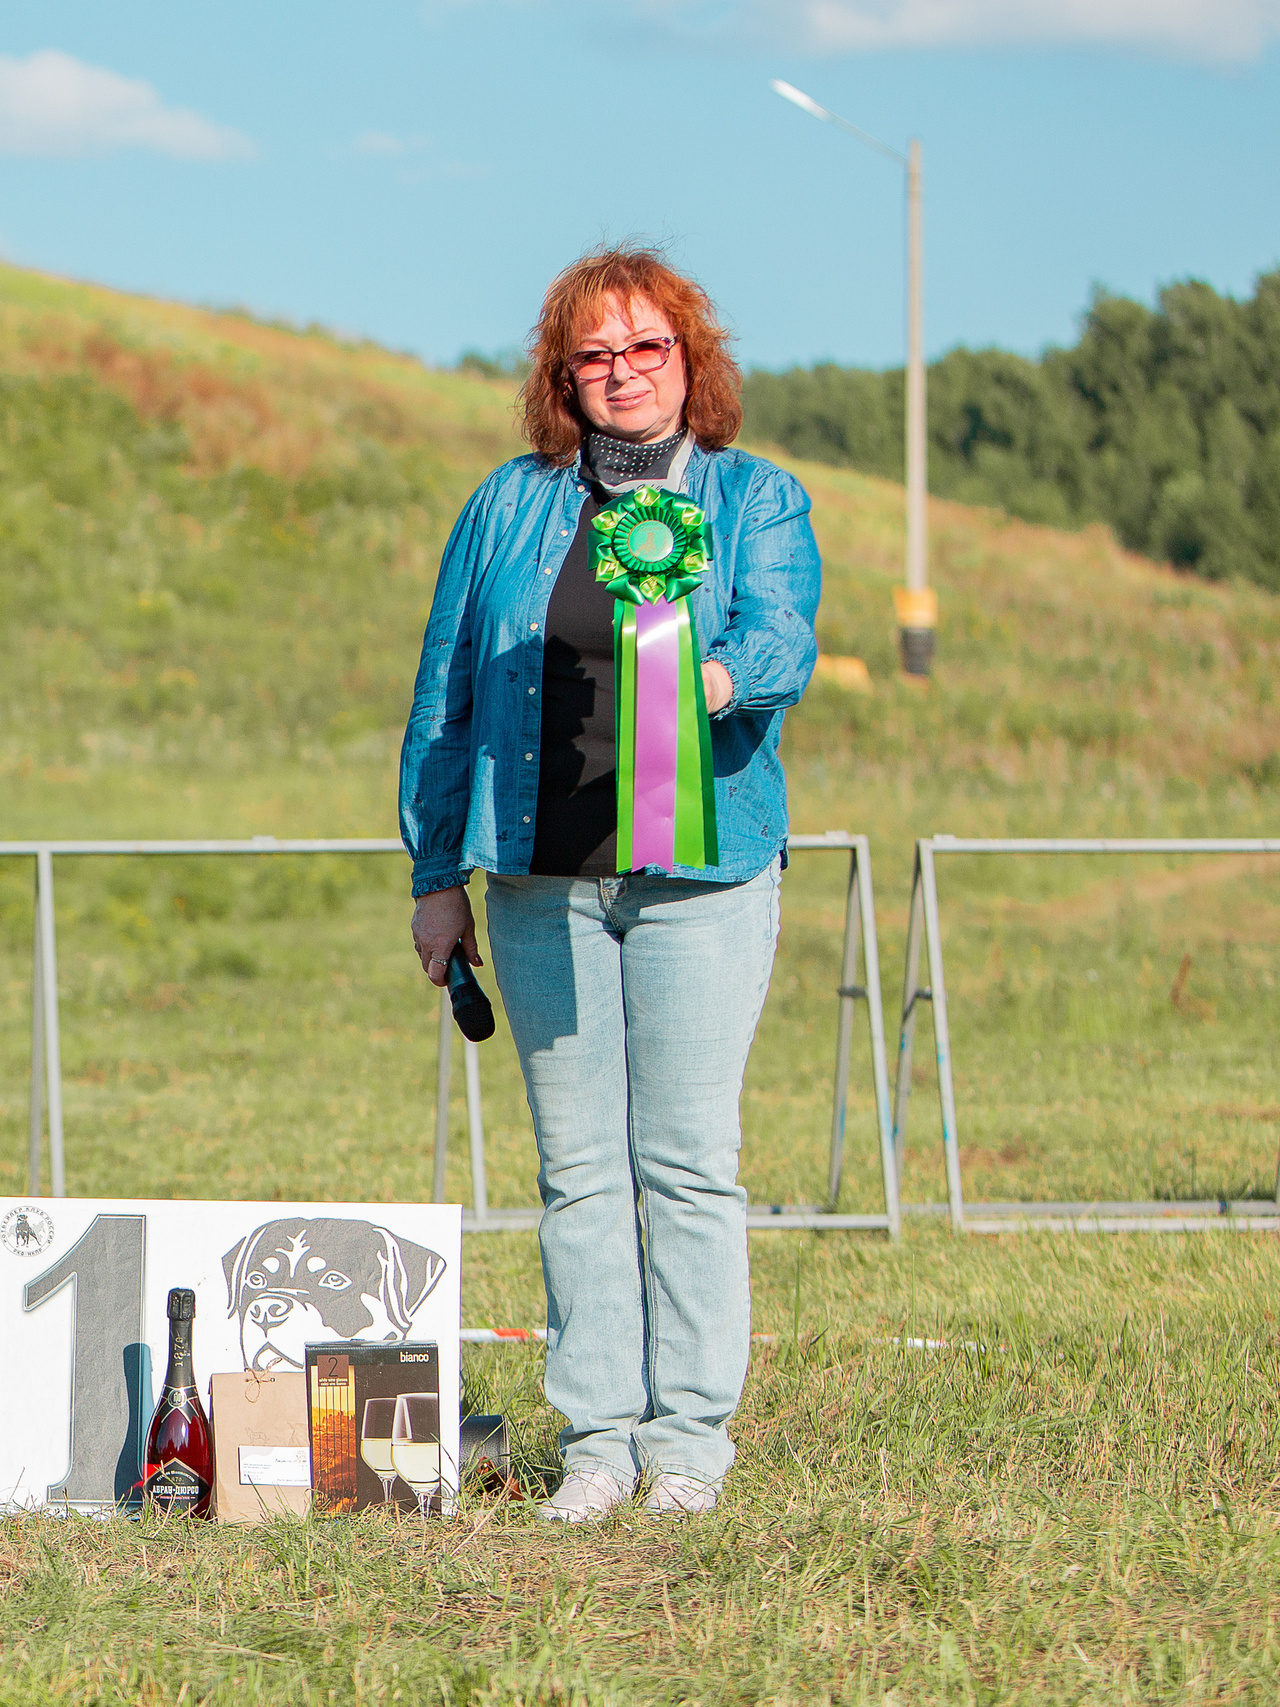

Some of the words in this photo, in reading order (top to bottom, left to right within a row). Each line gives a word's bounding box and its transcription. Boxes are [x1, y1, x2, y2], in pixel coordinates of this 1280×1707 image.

[23, 1214, 147, 1504] 1
[328, 1356, 339, 1377] 2
[399, 1351, 430, 1363] bianco
